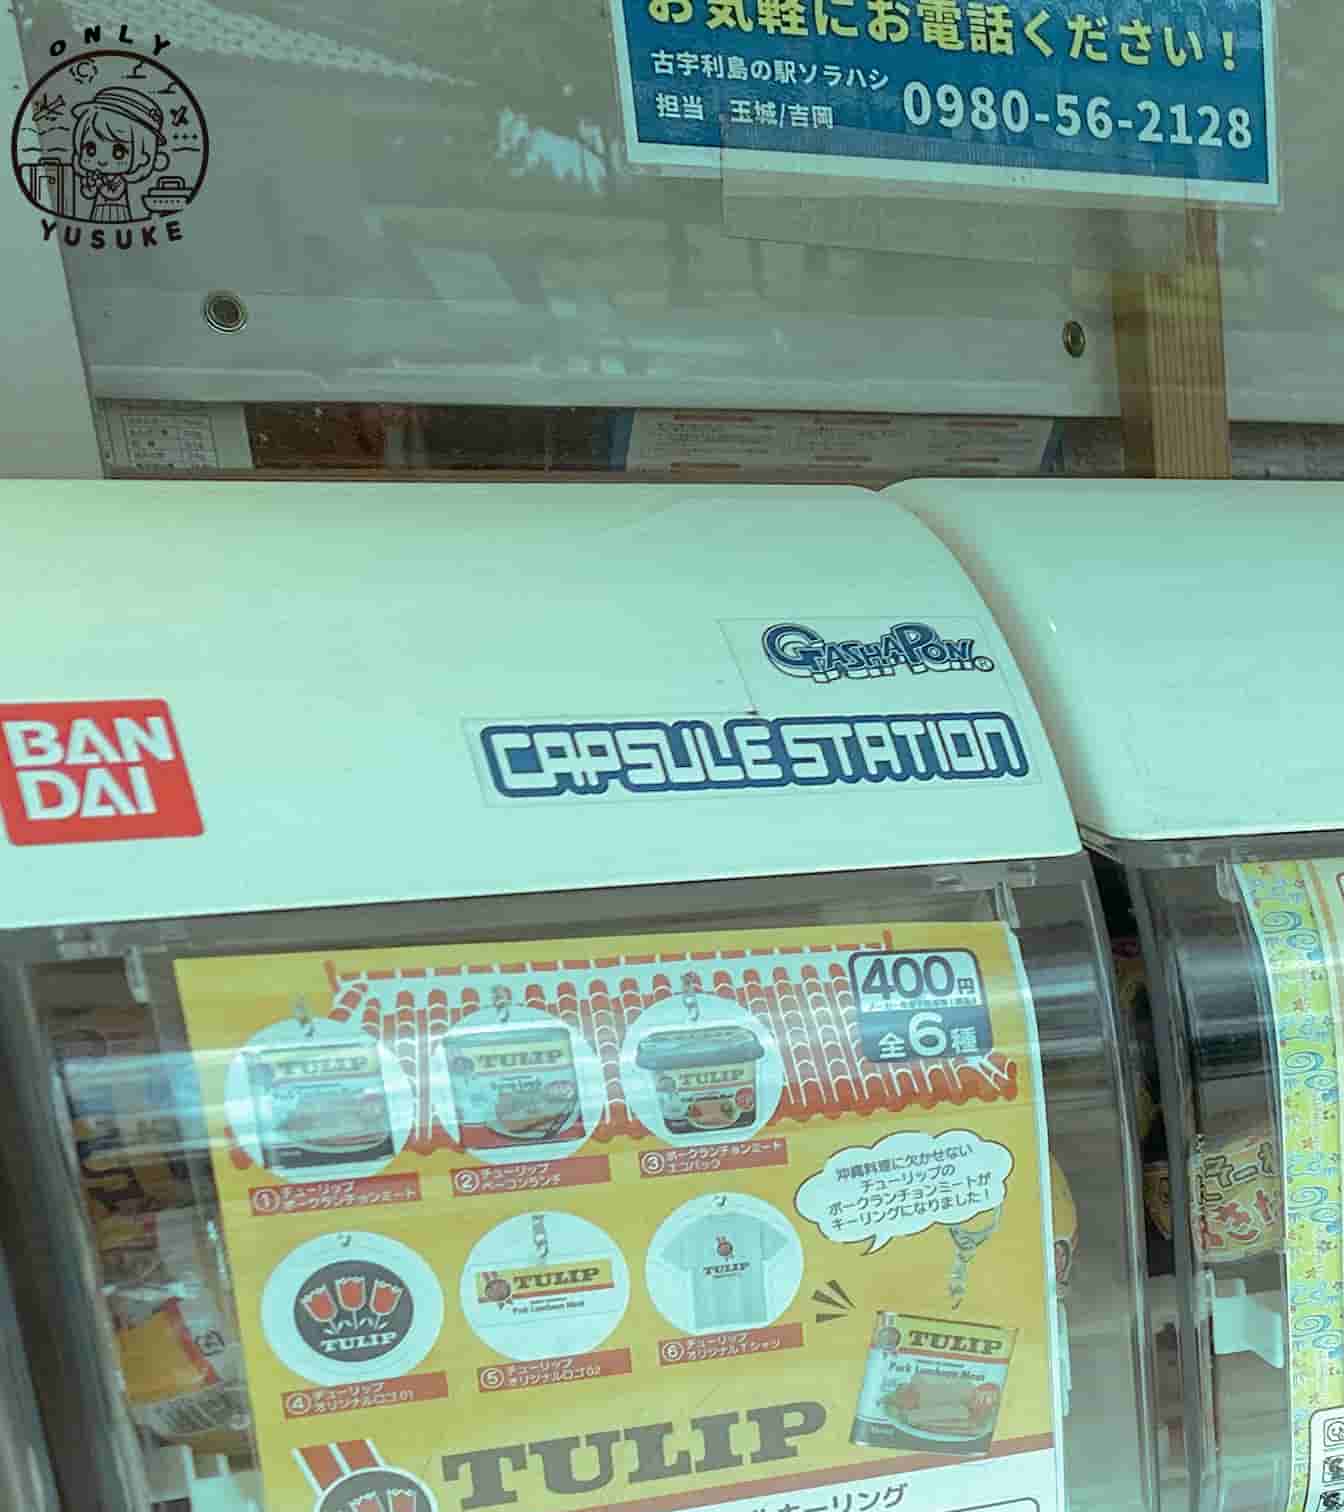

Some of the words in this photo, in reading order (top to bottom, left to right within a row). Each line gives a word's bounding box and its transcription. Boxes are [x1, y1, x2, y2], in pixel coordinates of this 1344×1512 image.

[650, 48, 889, 92] 古宇利島の駅ソラハシ
[655, 94, 705, 121] 担当
[904, 80, 1252, 150] 0980-56-2128
[2, 716, 173, 769] BAN
[22, 763, 158, 820] DAI
[862, 954, 976, 1000] 400円
[879, 1011, 978, 1059] 全6種
[836, 1144, 973, 1183] 沖縄料理に欠かせない
[861, 1163, 956, 1194] チューリップの
[512, 1267, 600, 1290] TULIP
[702, 1261, 750, 1276] TULIP
[320, 1331, 398, 1353] TULIP
[909, 1330, 1003, 1356] TULIP
[440, 1399, 828, 1511] TULIP
